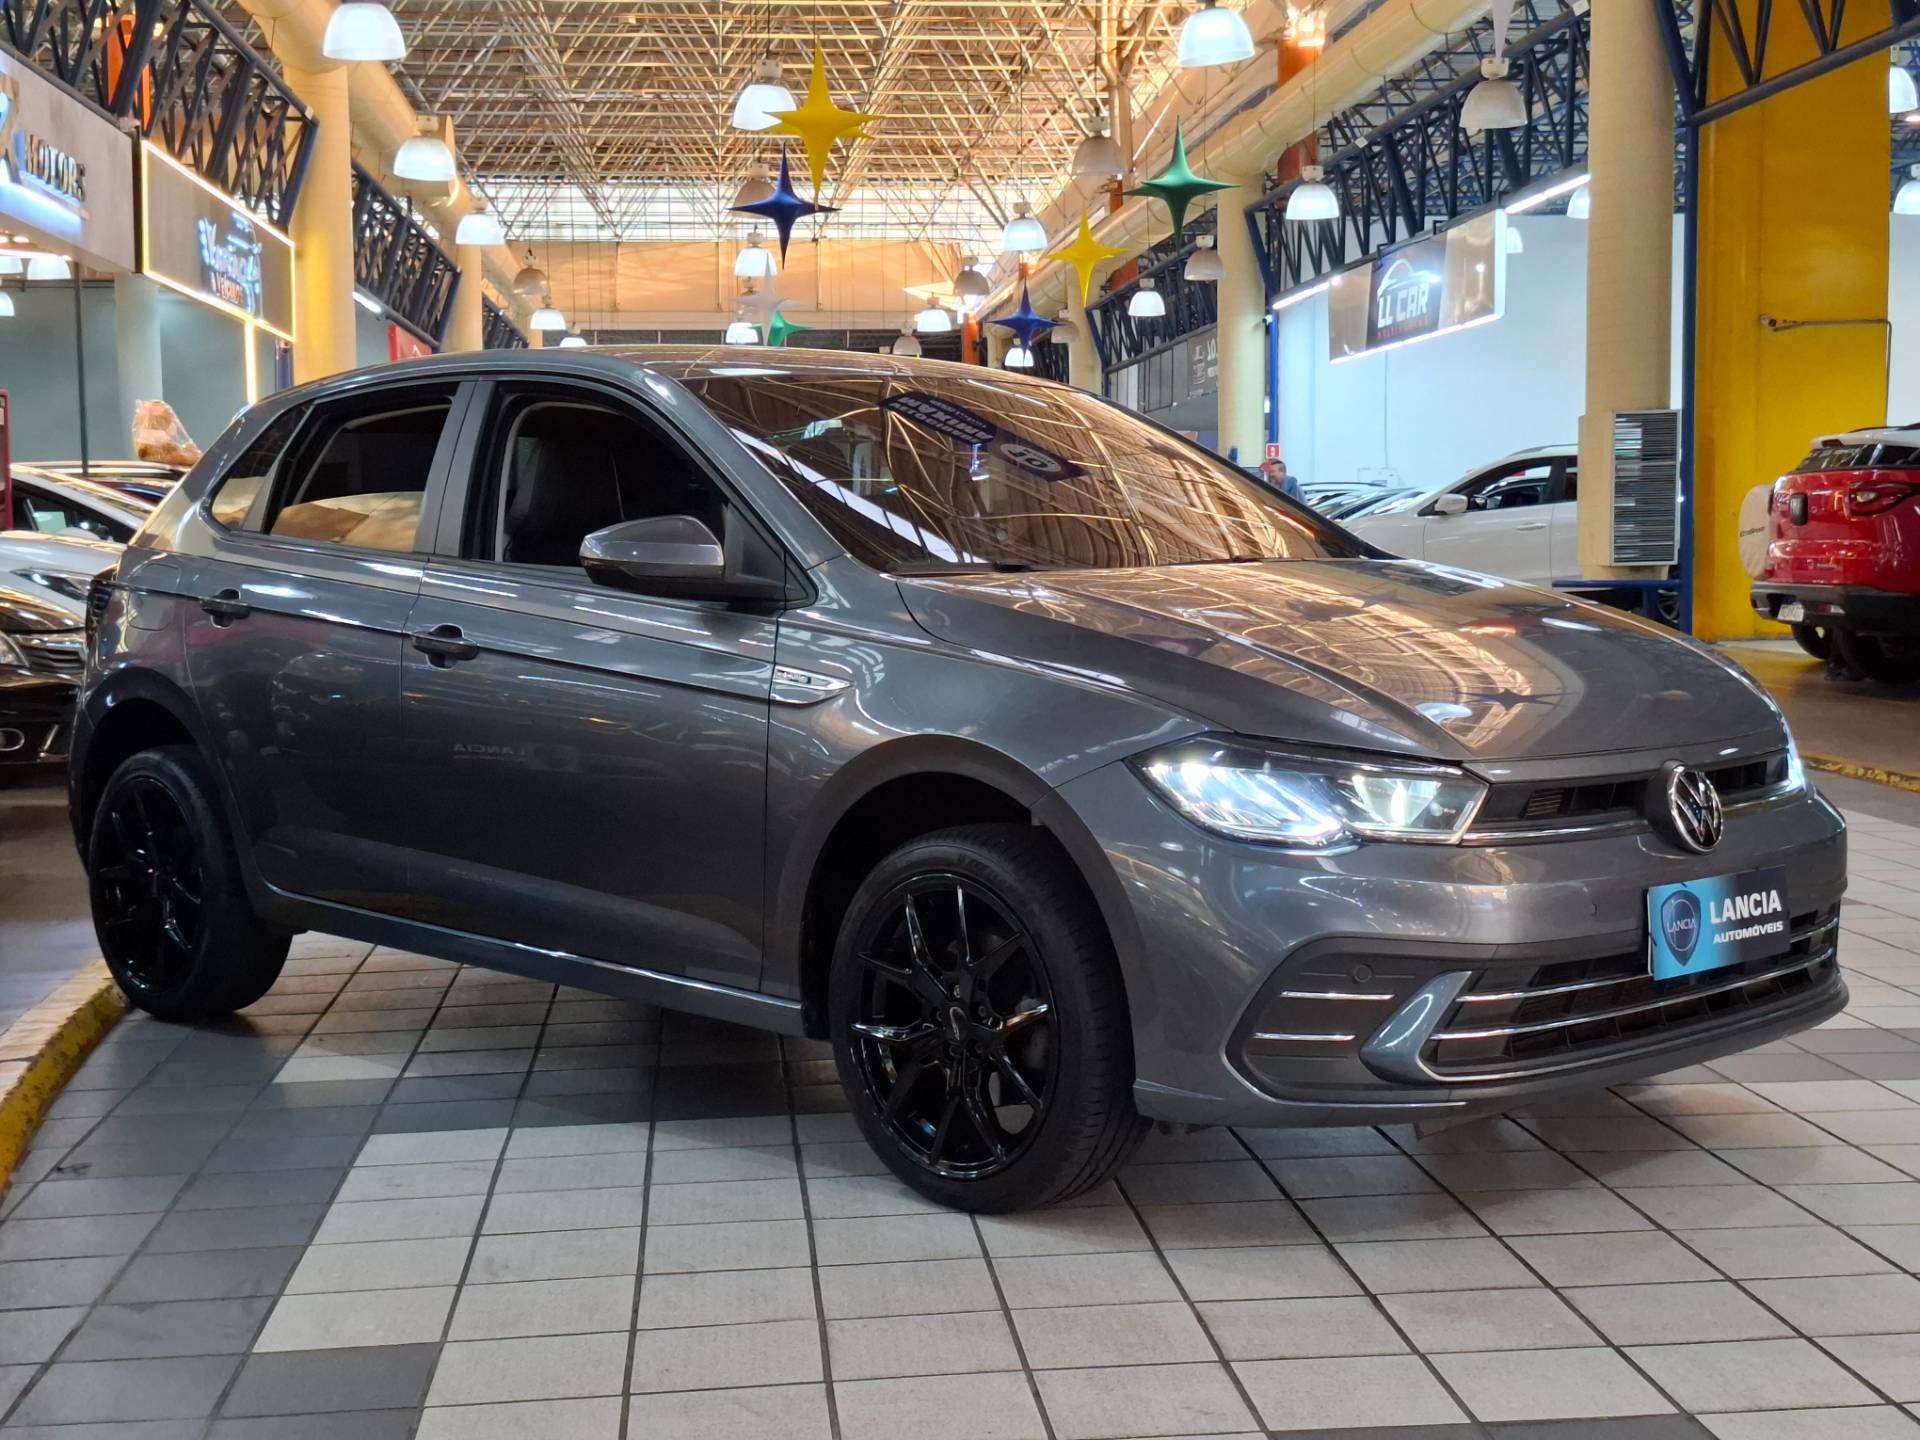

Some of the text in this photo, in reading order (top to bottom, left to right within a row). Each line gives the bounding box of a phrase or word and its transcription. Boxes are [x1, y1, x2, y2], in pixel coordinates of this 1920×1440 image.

[24, 131, 86, 202] MOTORS
[1396, 281, 1429, 322] CAR
[1709, 889, 1783, 924] LANCIA
[1666, 918, 1697, 933] LANCIA
[1713, 921, 1784, 944] AUTOMÓVEIS
